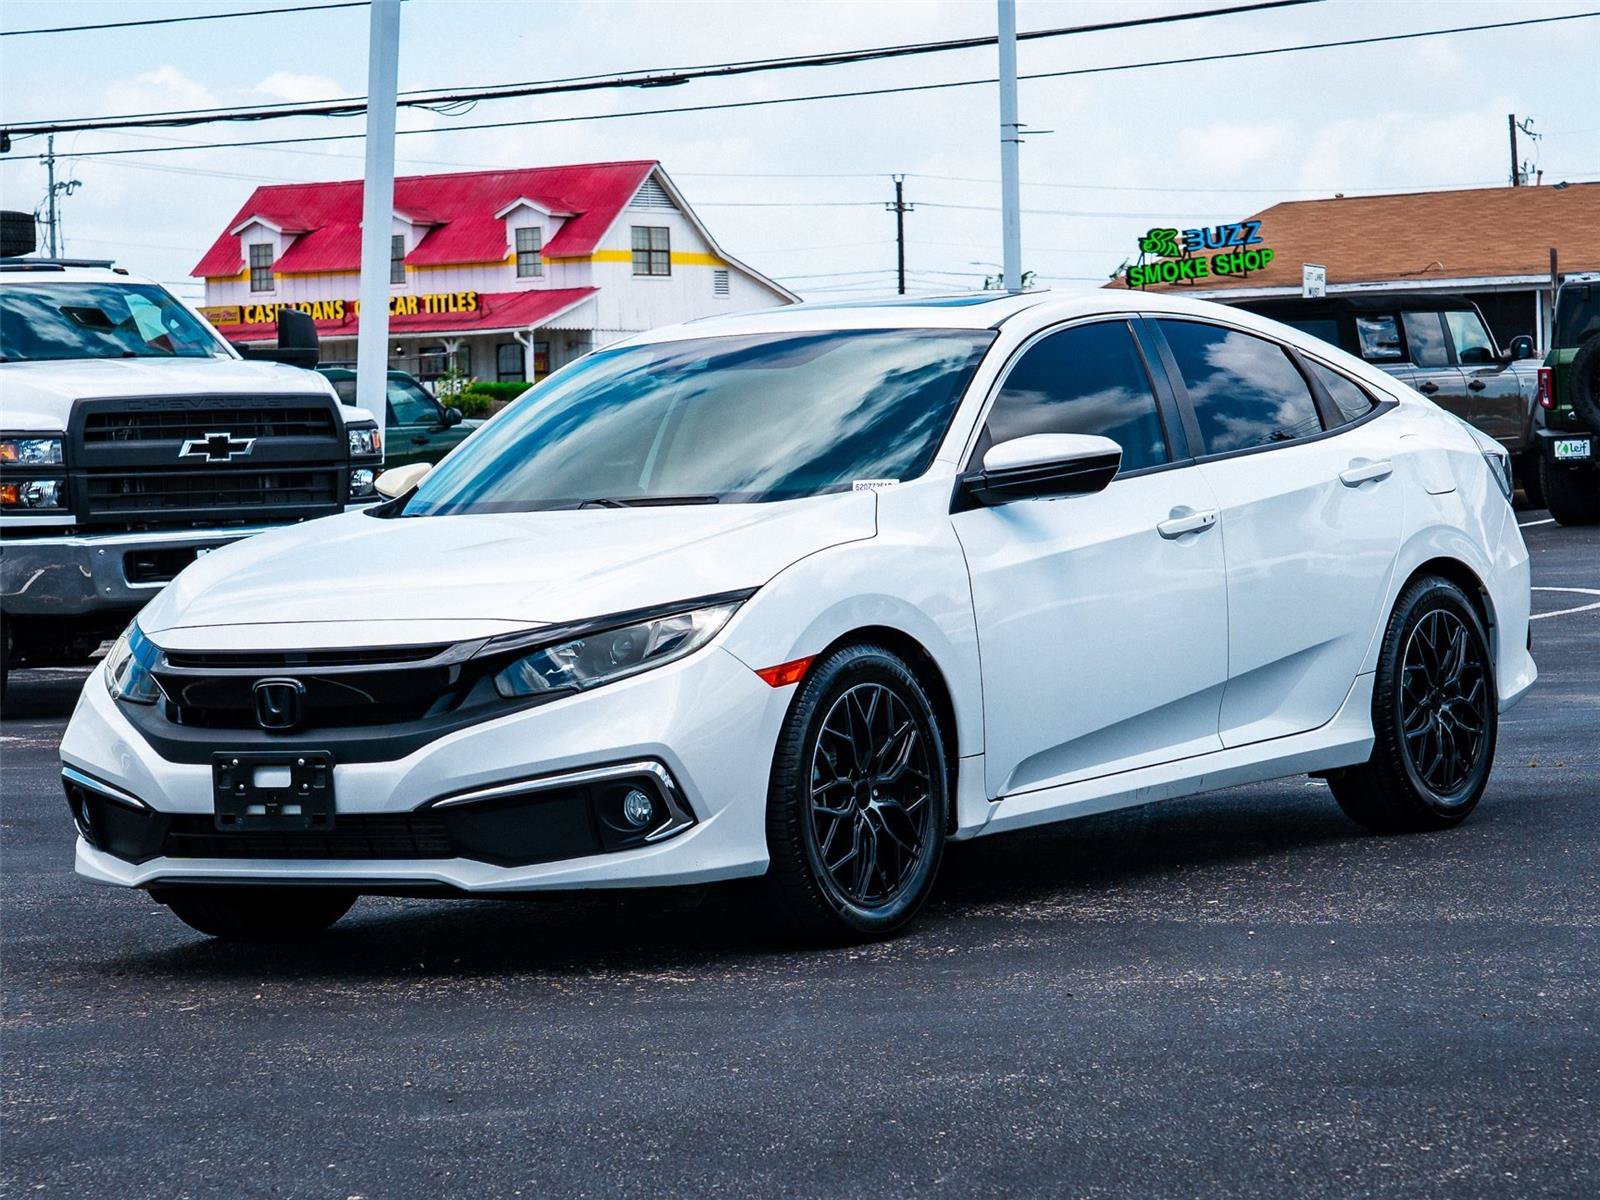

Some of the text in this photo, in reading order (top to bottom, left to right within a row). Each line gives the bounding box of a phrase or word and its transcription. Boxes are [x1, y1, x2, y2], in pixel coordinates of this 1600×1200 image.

[1183, 220, 1264, 251] BUZZ
[1127, 248, 1275, 288] SMOKE SHOP
[291, 300, 345, 320] OANS
[388, 295, 419, 317] CAR
[421, 291, 478, 314] TITLES
